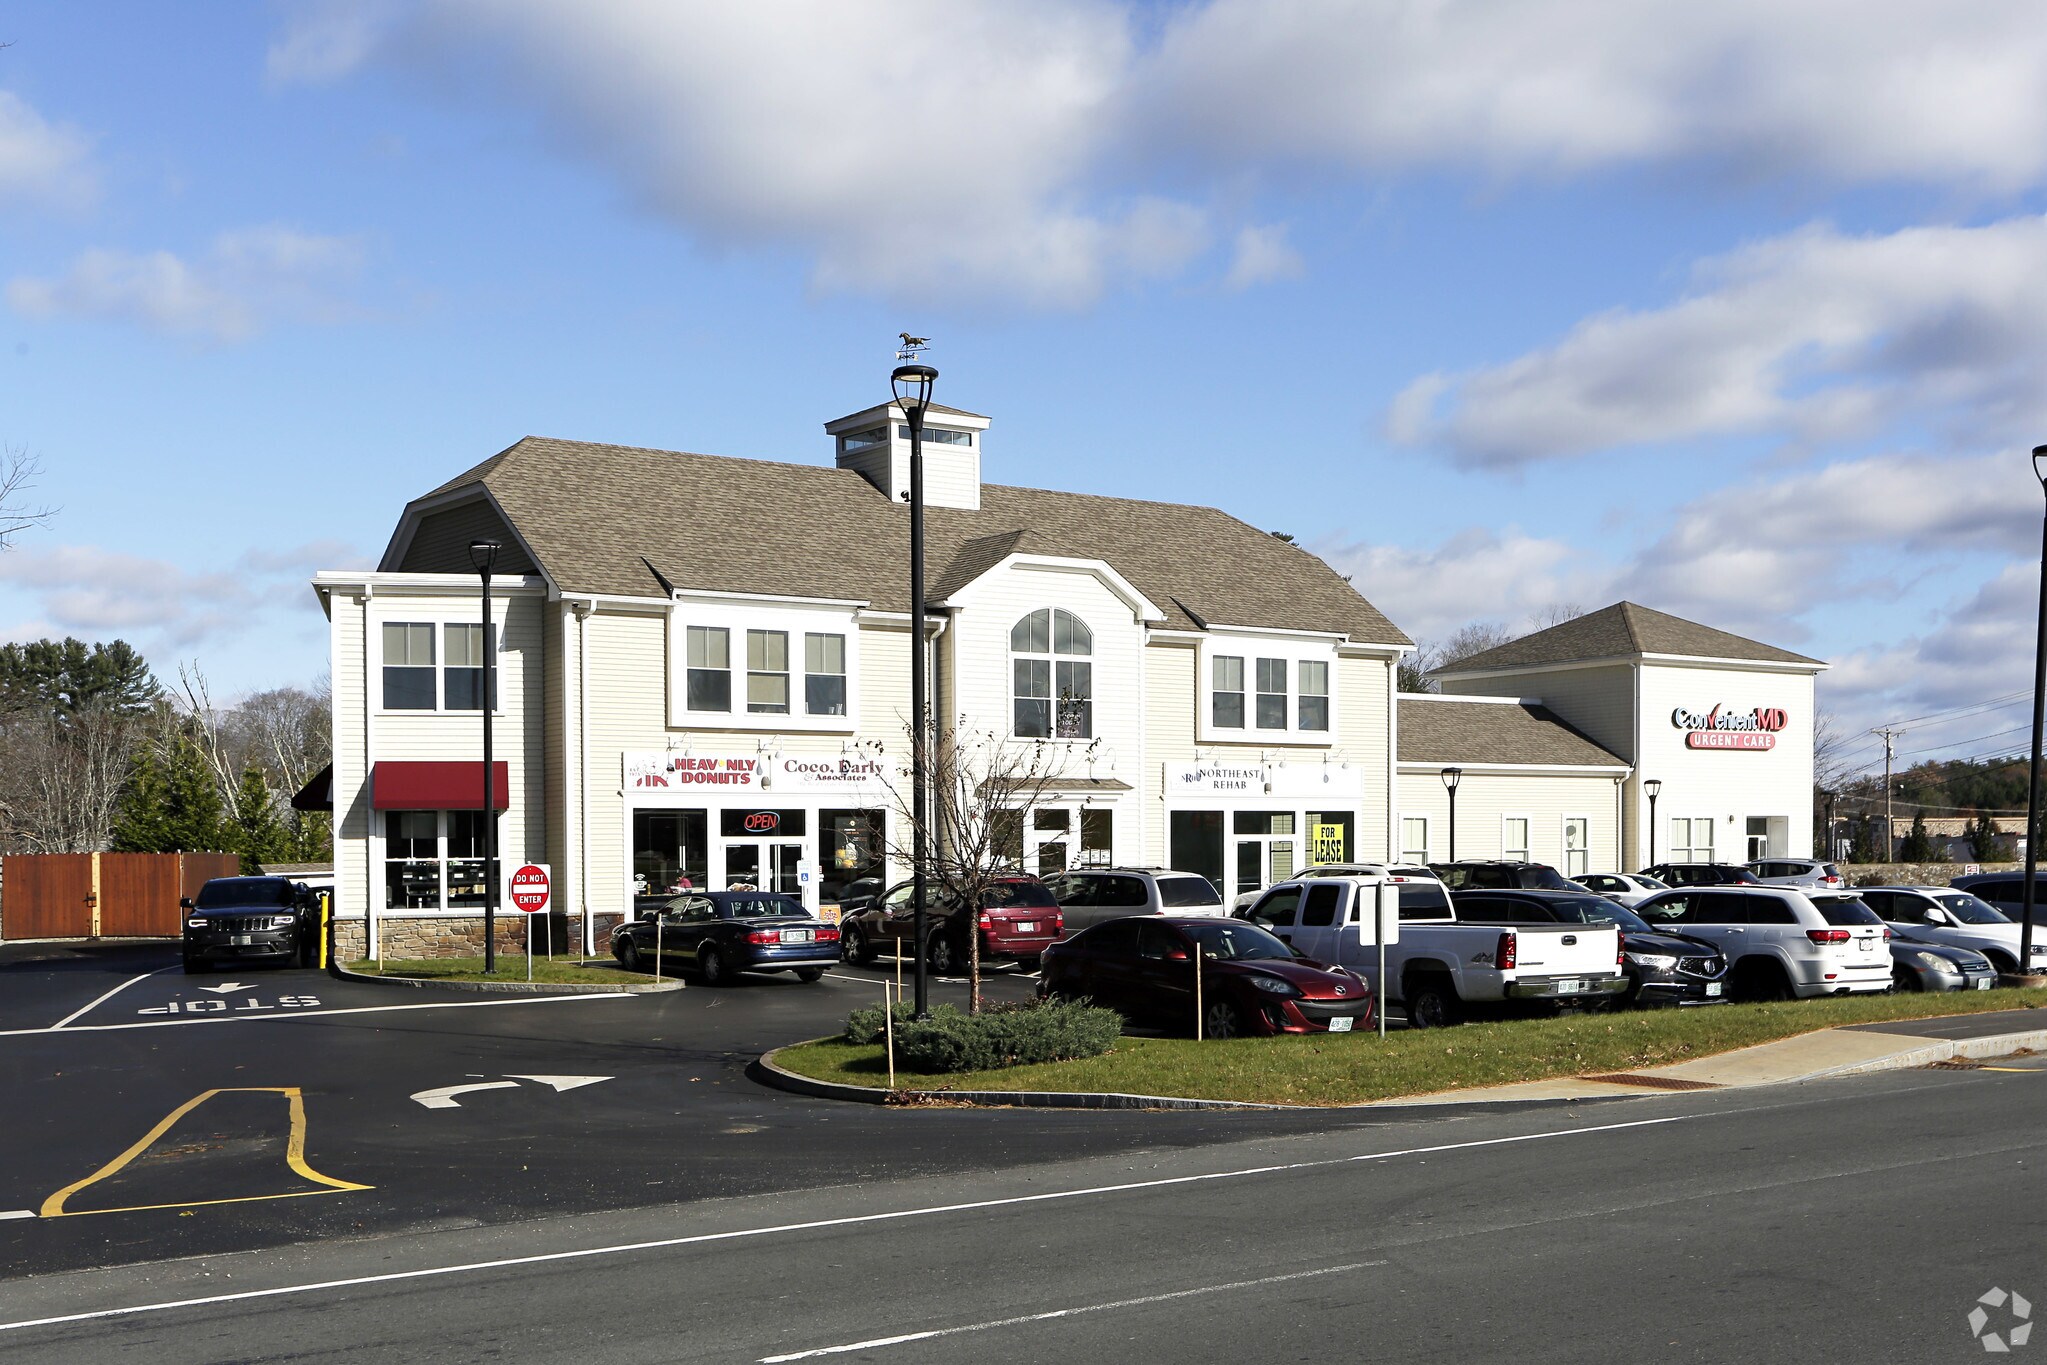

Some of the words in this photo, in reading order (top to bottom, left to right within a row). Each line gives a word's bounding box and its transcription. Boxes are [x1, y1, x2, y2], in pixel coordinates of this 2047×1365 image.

[1673, 702, 1788, 731] ConvenientMD
[1694, 734, 1739, 746] URGENT
[1743, 735, 1772, 747] CARE
[784, 759, 834, 773] Coco,
[838, 760, 884, 774] Early
[681, 772, 751, 784] DONUTS
[815, 773, 867, 781] Associates
[1199, 769, 1260, 779] NORTHEAST
[1213, 781, 1247, 789] REHAB
[745, 814, 777, 829] OPEN
[1321, 827, 1335, 838] FOR
[1315, 839, 1342, 863] LEASE
[516, 874, 527, 883] DO
[529, 874, 544, 883] NOT
[519, 895, 542, 904] ENTER
[137, 995, 321, 1015] STOP
